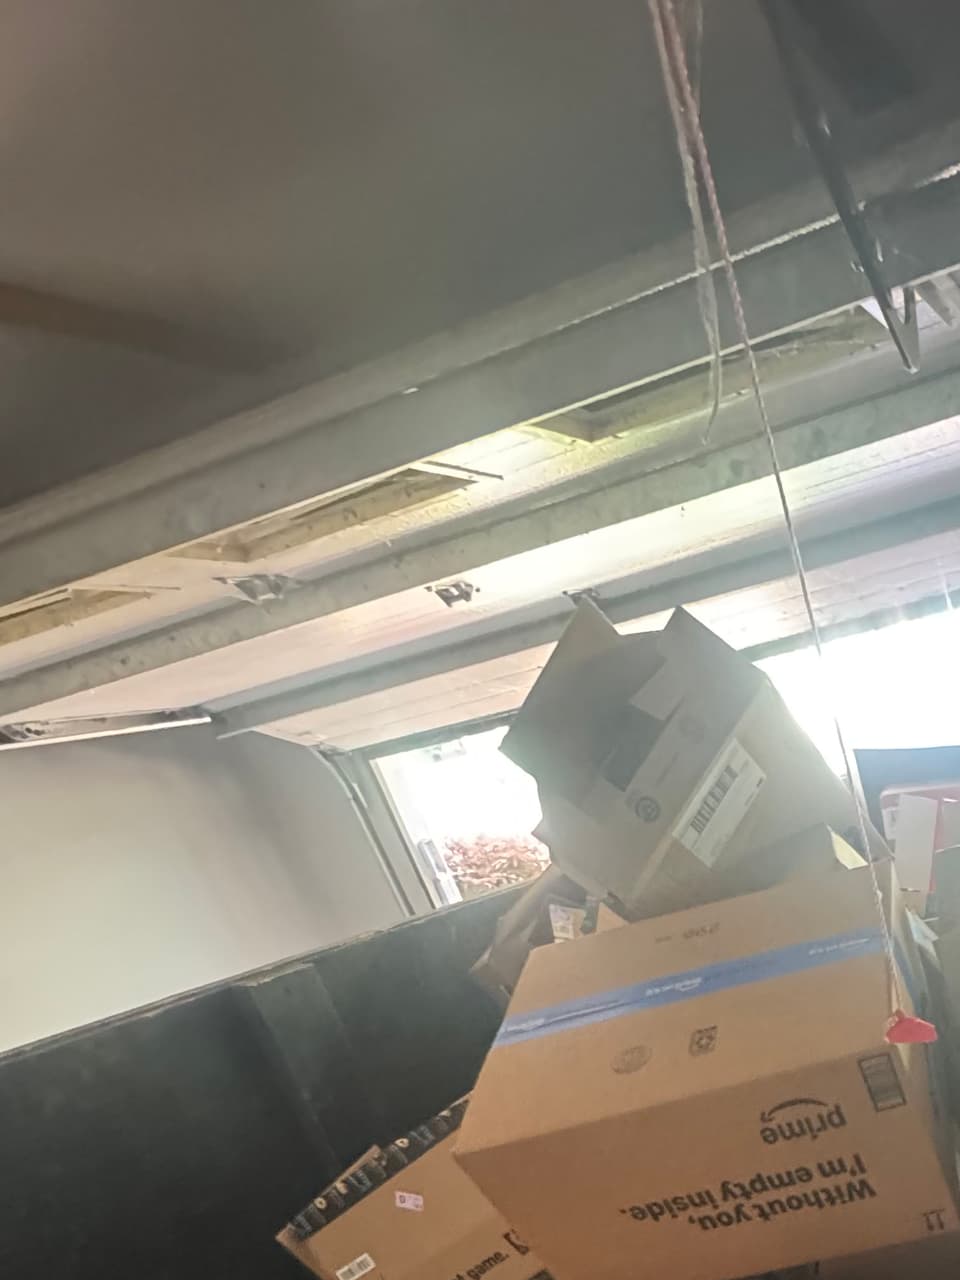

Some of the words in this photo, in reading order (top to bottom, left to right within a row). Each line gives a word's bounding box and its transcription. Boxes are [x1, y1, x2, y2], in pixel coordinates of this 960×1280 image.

[760, 1103, 847, 1145] prime
[720, 1165, 814, 1201] empty
[816, 1153, 868, 1179] I'm
[619, 1188, 716, 1222] inside.
[687, 1203, 751, 1231] you,
[757, 1178, 877, 1222] Without
